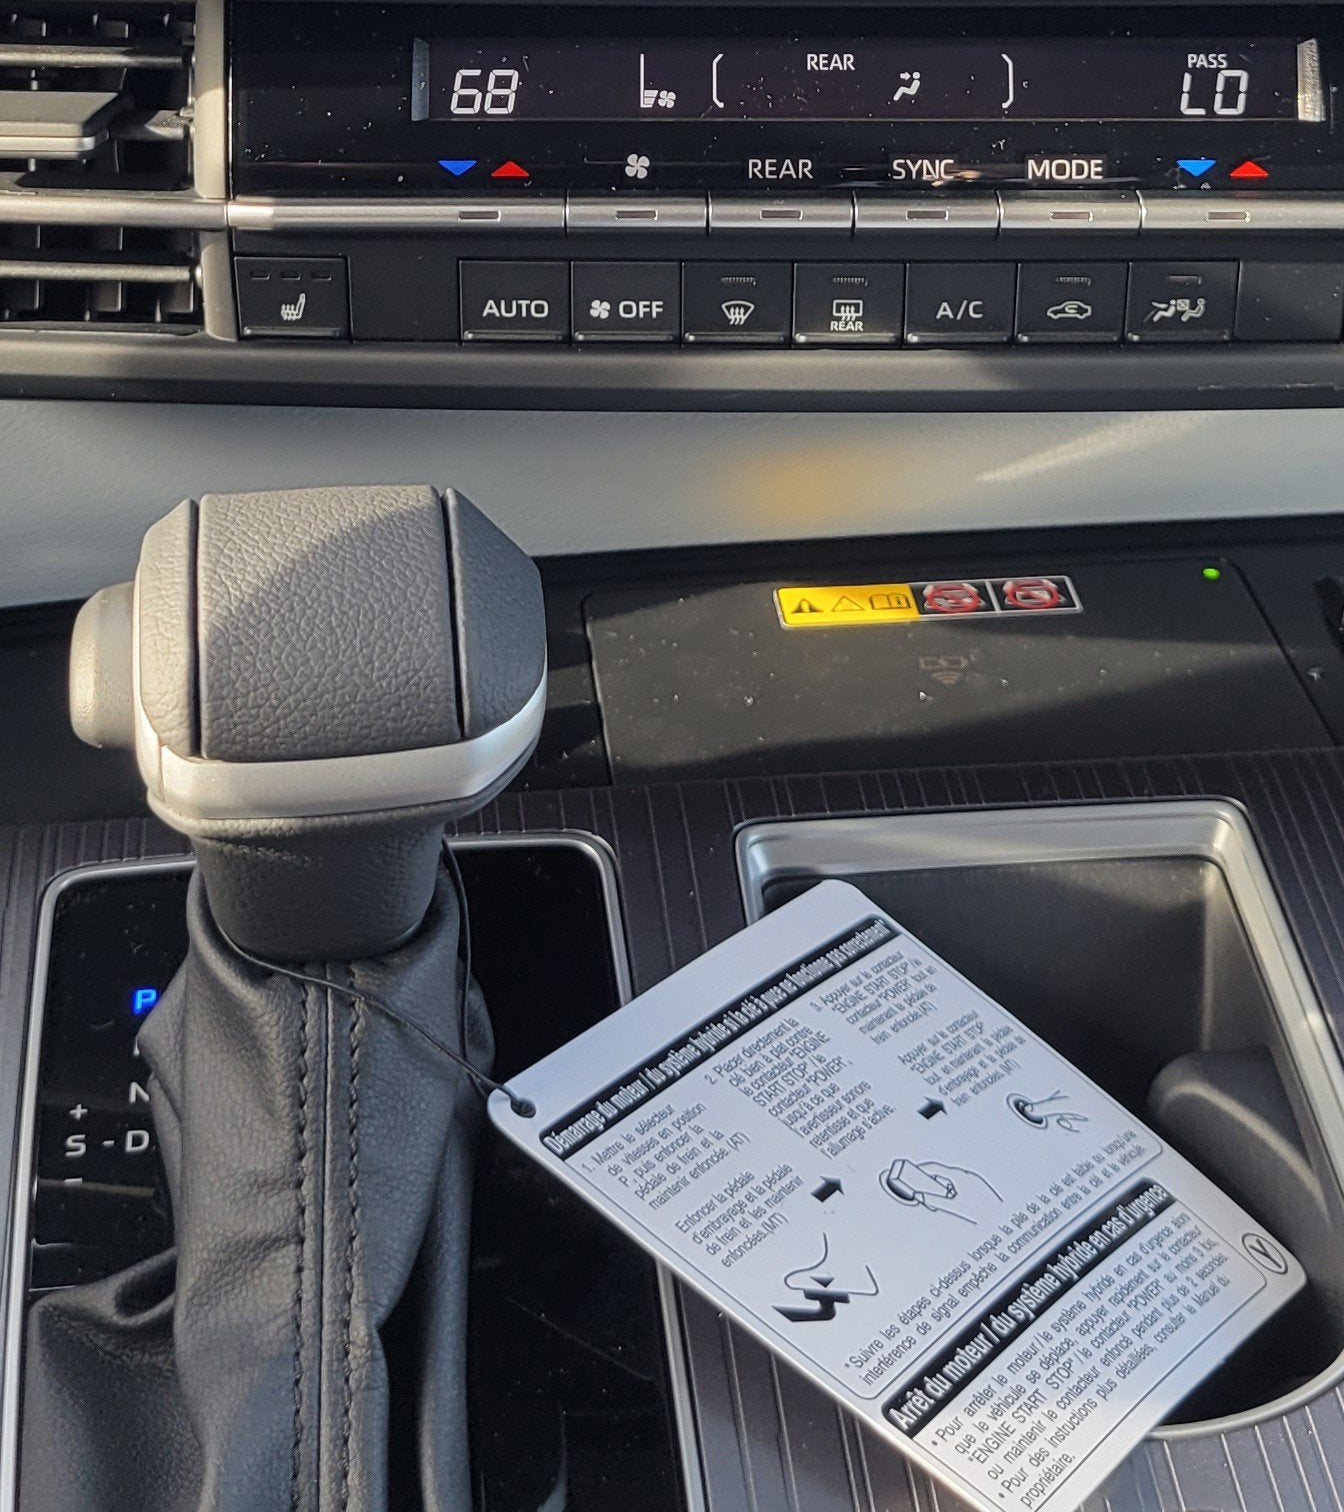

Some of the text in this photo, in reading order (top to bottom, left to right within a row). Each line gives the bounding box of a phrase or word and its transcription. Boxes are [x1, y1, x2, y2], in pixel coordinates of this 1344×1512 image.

[806, 53, 1228, 71] REAR PASS
[450, 69, 518, 114] 68
[748, 159, 1104, 180] REAR SYNC MODE
[482, 299, 984, 320] AUTO OFF A/C
[830, 321, 864, 332] REAR
[134, 989, 157, 1014] P
[741, 999, 762, 1019] clé
[760, 986, 787, 1008] puce
[723, 1013, 740, 1031] si
[728, 1010, 749, 1025] la
[689, 1023, 731, 1051] hybride
[645, 1067, 666, 1084] du
[659, 1044, 701, 1076] système
[596, 1100, 618, 1118] du
[610, 1079, 648, 1109] moteur
[544, 1110, 605, 1153] Démarrage
[591, 1141, 625, 1165] Mettre
[620, 1133, 636, 1144] le
[635, 1104, 674, 1135] sélecteur
[607, 1103, 706, 1176] de vitesses en position
[633, 1159, 656, 1178] puis
[654, 1131, 692, 1162] enfoncer
[688, 1124, 704, 1135] la
[634, 1129, 724, 1201] pédale de frein et la
[648, 1176, 690, 1210] maintenir
[725, 1131, 751, 1150] (AT)
[675, 1171, 755, 1233] Enfoncer la pédale
[692, 1164, 793, 1244] d'embrayage et la pédale
[706, 1175, 803, 1255] de frein et les maintenir
[890, 1177, 1168, 1428] Arrêt du moteur / du système hybride en cas d'urgence
[954, 1433, 976, 1454] que
[972, 1420, 989, 1433] le
[987, 1384, 1026, 1420] véhicule
[1025, 1370, 1041, 1384] se
[1039, 1337, 1079, 1370] déplace,
[1075, 1304, 1109, 1336] appuyer
[1108, 1269, 1149, 1306] rapidement
[1000, 1466, 1029, 1493] Pour
[1028, 1447, 1050, 1467] des
[1045, 1398, 1098, 1447] instructions
[1095, 1377, 1117, 1401] plus
[1115, 1343, 1157, 1379] détaillées,
[1153, 1312, 1186, 1343] consulter
[1182, 1304, 1197, 1315] le
[1191, 1280, 1220, 1307] Manuel
[1020, 1453, 1075, 1508] propriétaire.
